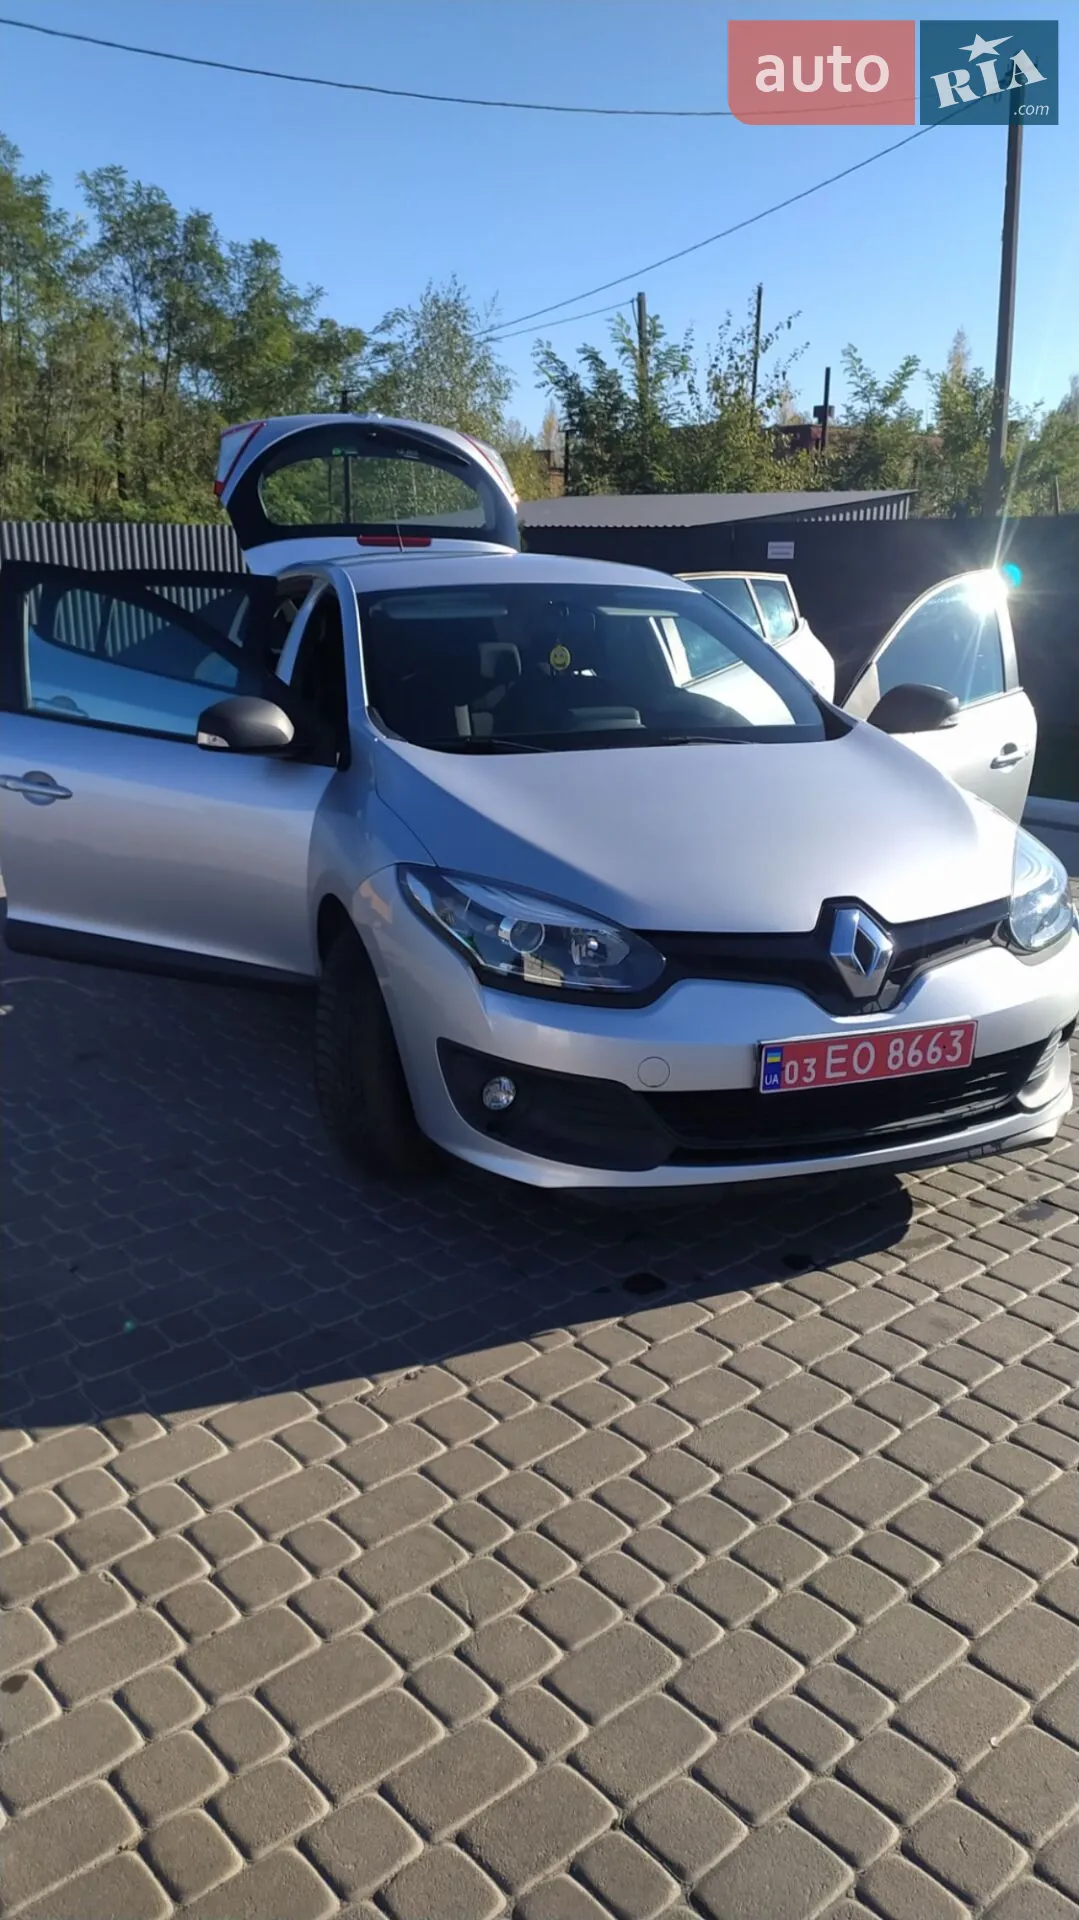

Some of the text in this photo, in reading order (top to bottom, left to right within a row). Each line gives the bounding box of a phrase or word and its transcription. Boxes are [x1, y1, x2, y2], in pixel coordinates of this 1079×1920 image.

[784, 1029, 965, 1085] 03 EO 8663
[764, 1073, 779, 1086] UA
